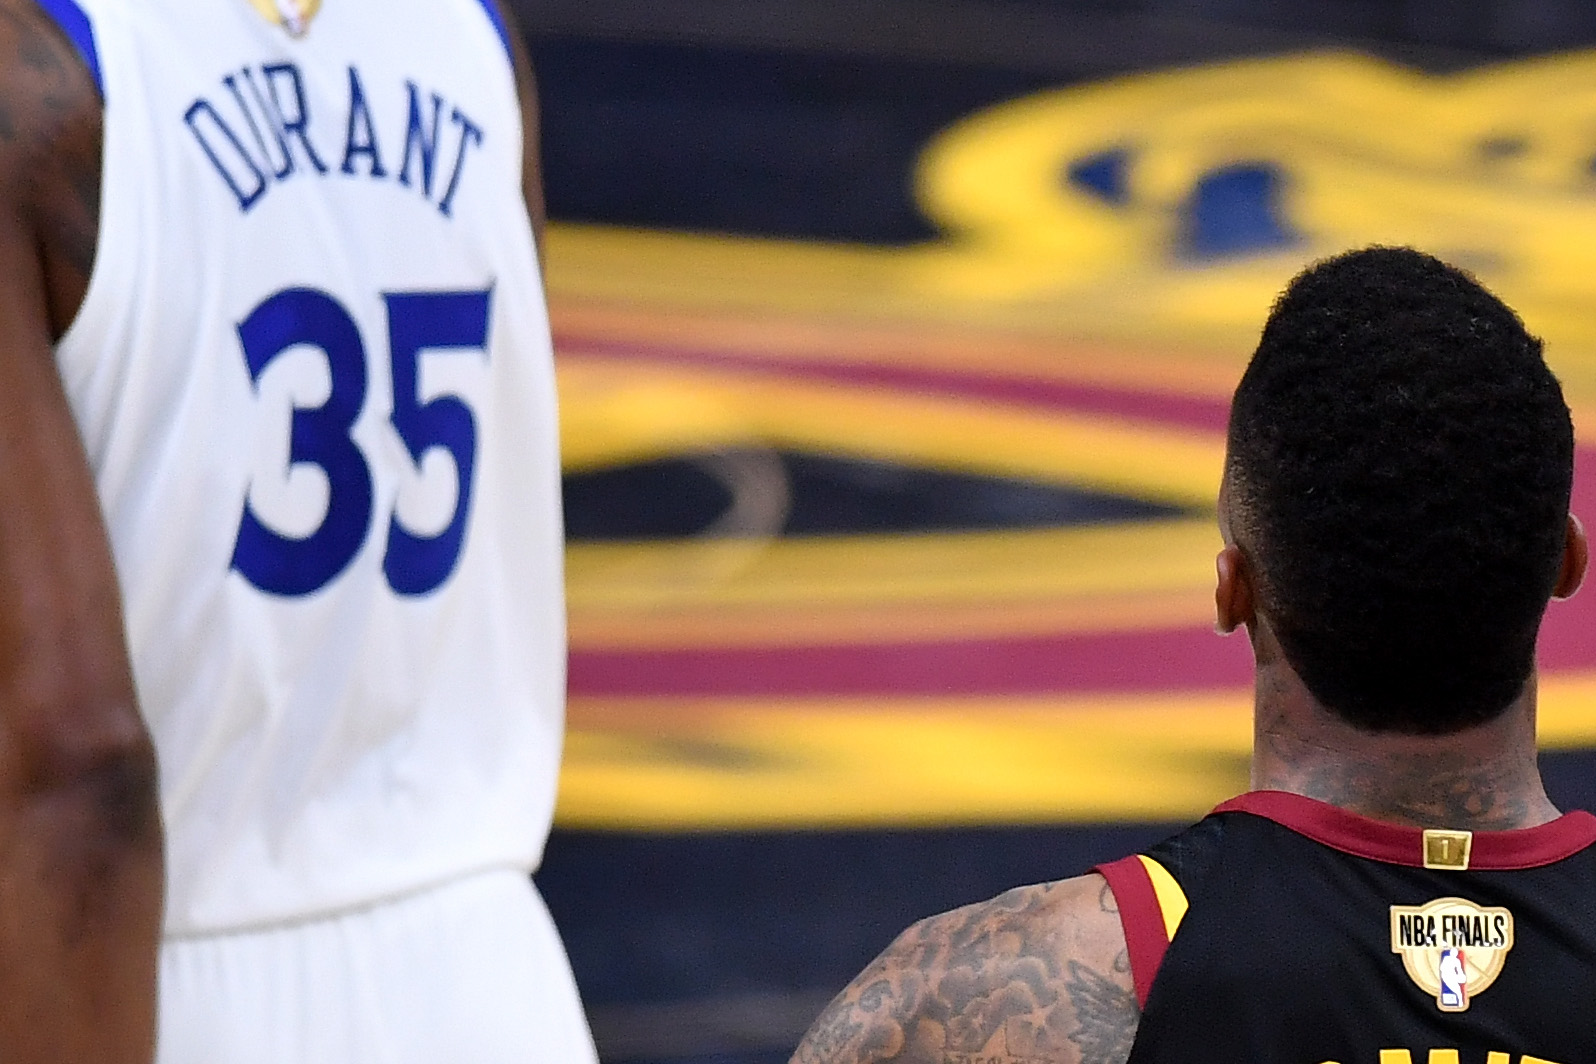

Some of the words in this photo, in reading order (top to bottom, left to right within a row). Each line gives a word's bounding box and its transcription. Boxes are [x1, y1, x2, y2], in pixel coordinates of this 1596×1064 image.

[183, 62, 484, 218] DURANT
[229, 279, 497, 598] 35
[1399, 914, 1437, 947] NBA
[1442, 914, 1505, 947] FINALS
